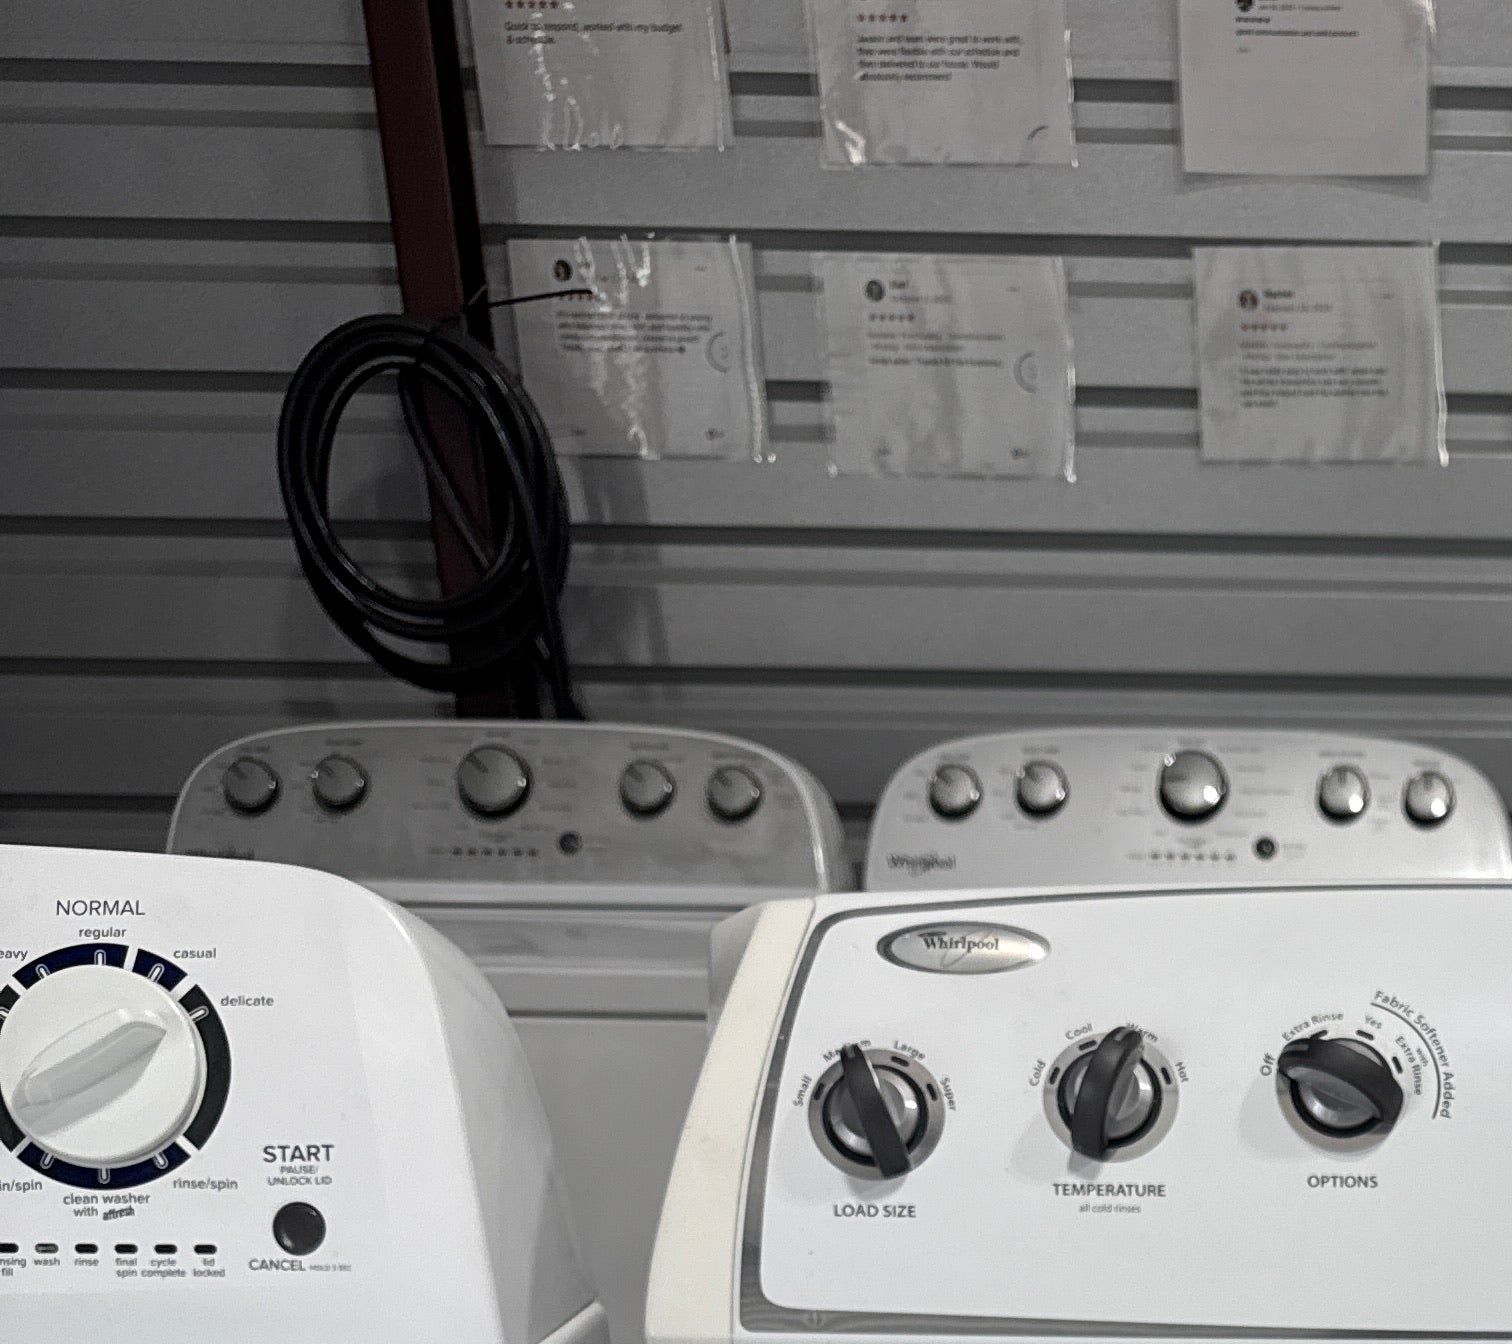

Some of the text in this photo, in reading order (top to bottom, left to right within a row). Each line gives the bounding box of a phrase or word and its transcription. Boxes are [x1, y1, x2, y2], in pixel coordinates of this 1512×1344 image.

[56, 900, 145, 916] NORMAL
[79, 927, 126, 940] regular
[923, 936, 999, 953] Whirlpool
[173, 948, 216, 959] casual
[220, 995, 274, 1007] delicate
[1281, 1012, 1344, 1041] Extra Rinse
[1364, 1014, 1382, 1030] Yes
[1065, 1023, 1093, 1041] Cool
[893, 1040, 926, 1061] Large
[1373, 990, 1455, 1119] Fabric Softener Added
[1259, 1052, 1276, 1077] Off
[1395, 1035, 1422, 1096] Extra Rinse
[1029, 1060, 1047, 1087] Cold
[1175, 1061, 1190, 1083] Hot
[793, 1074, 813, 1107] Small
[940, 1077, 956, 1112] Super
[263, 1144, 334, 1162] START
[173, 1178, 238, 1191] rinse/spin
[267, 1176, 333, 1186] UNLOCK LID
[1307, 1175, 1378, 1188] OPTIONS
[1053, 1183, 1166, 1197] TEMPERATURE
[63, 1193, 151, 1205] clean washer
[73, 1207, 98, 1217] with
[833, 1204, 917, 1218] LOAD SIZE
[34, 1257, 60, 1266] wash
[74, 1257, 99, 1266] rinse
[115, 1257, 137, 1266] final
[151, 1257, 177, 1268] cycle
[203, 1257, 215, 1266] lid
[248, 1259, 306, 1271] CANCEL
[2, 1267, 14, 1276] fill
[116, 1268, 137, 1278] spin
[141, 1268, 186, 1278] complete
[193, 1268, 226, 1277] locked
